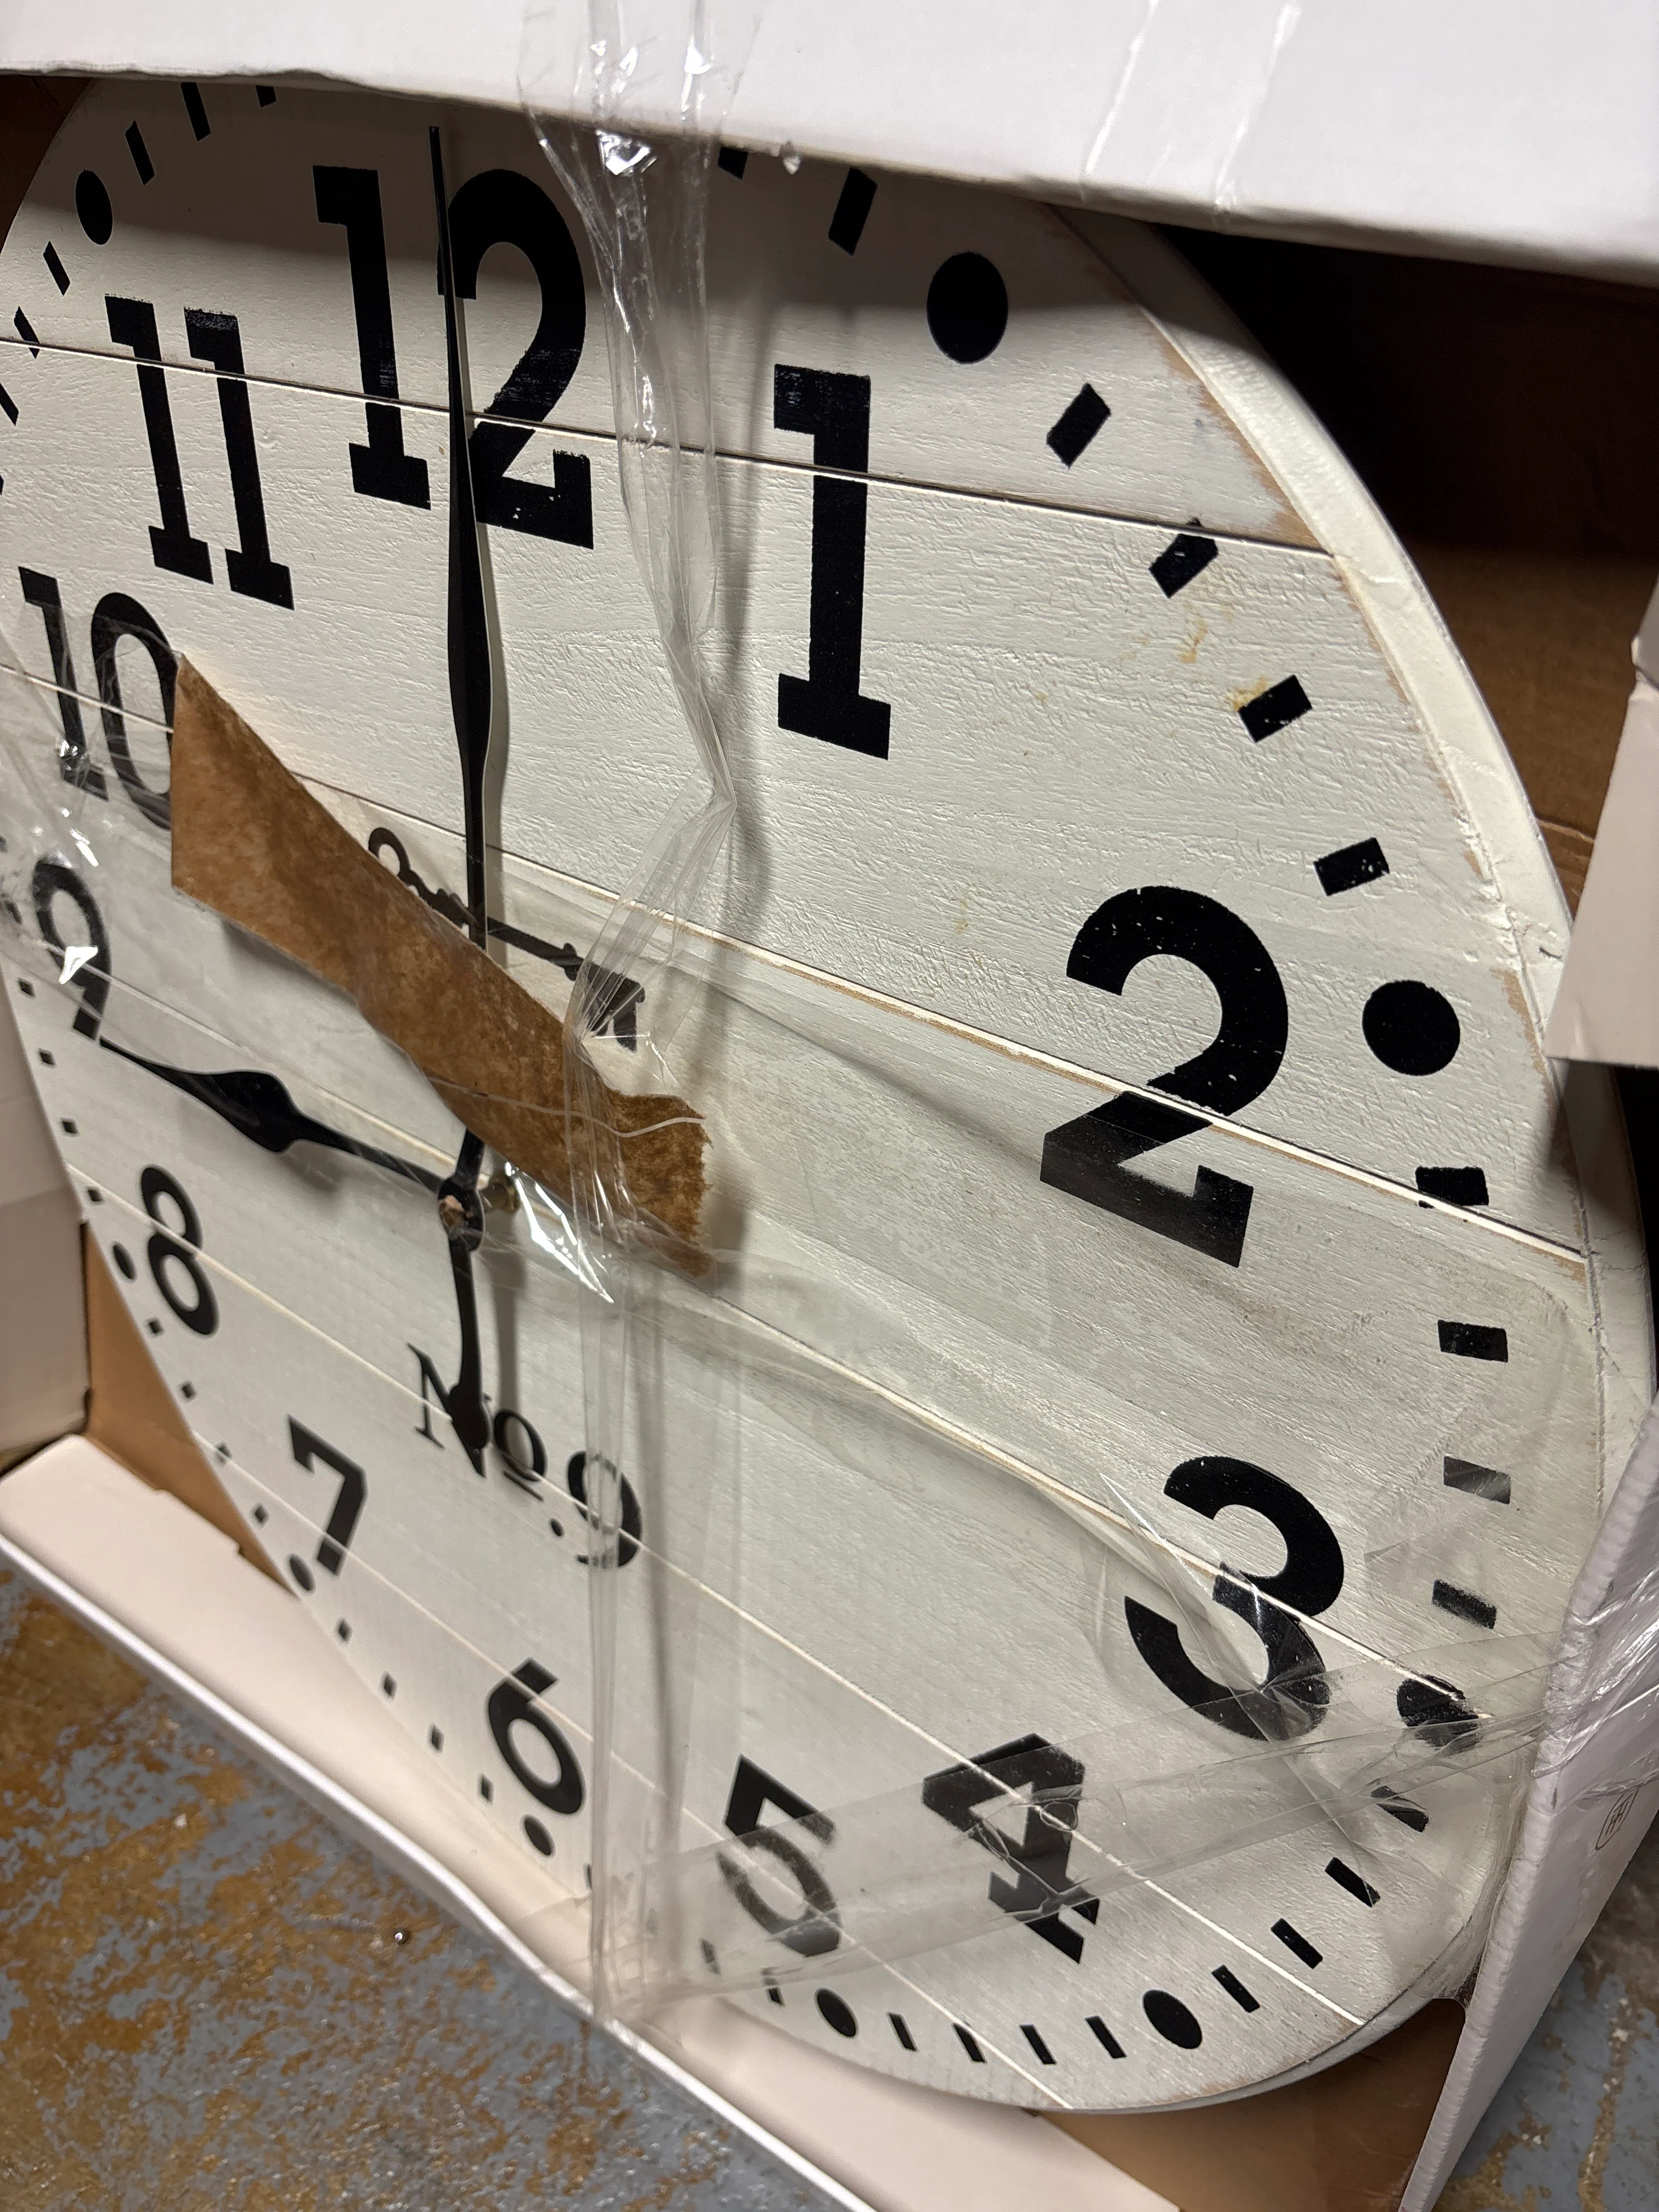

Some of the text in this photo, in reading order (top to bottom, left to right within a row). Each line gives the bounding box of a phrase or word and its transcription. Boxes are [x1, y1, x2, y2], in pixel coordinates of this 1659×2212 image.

[104, 294, 295, 610] 11
[313, 165, 594, 550] 12
[774, 363, 891, 760] 1
[18, 566, 178, 831] 10
[32, 853, 112, 1040] 9
[1040, 885, 1289, 1268] 2
[140, 1165, 218, 1335] 8
[287, 1414, 368, 1576] 7
[1125, 1455, 1344, 1742] 3
[488, 1657, 583, 1815] 6
[716, 1753, 843, 1957] 5
[922, 1733, 1101, 1964] 4
